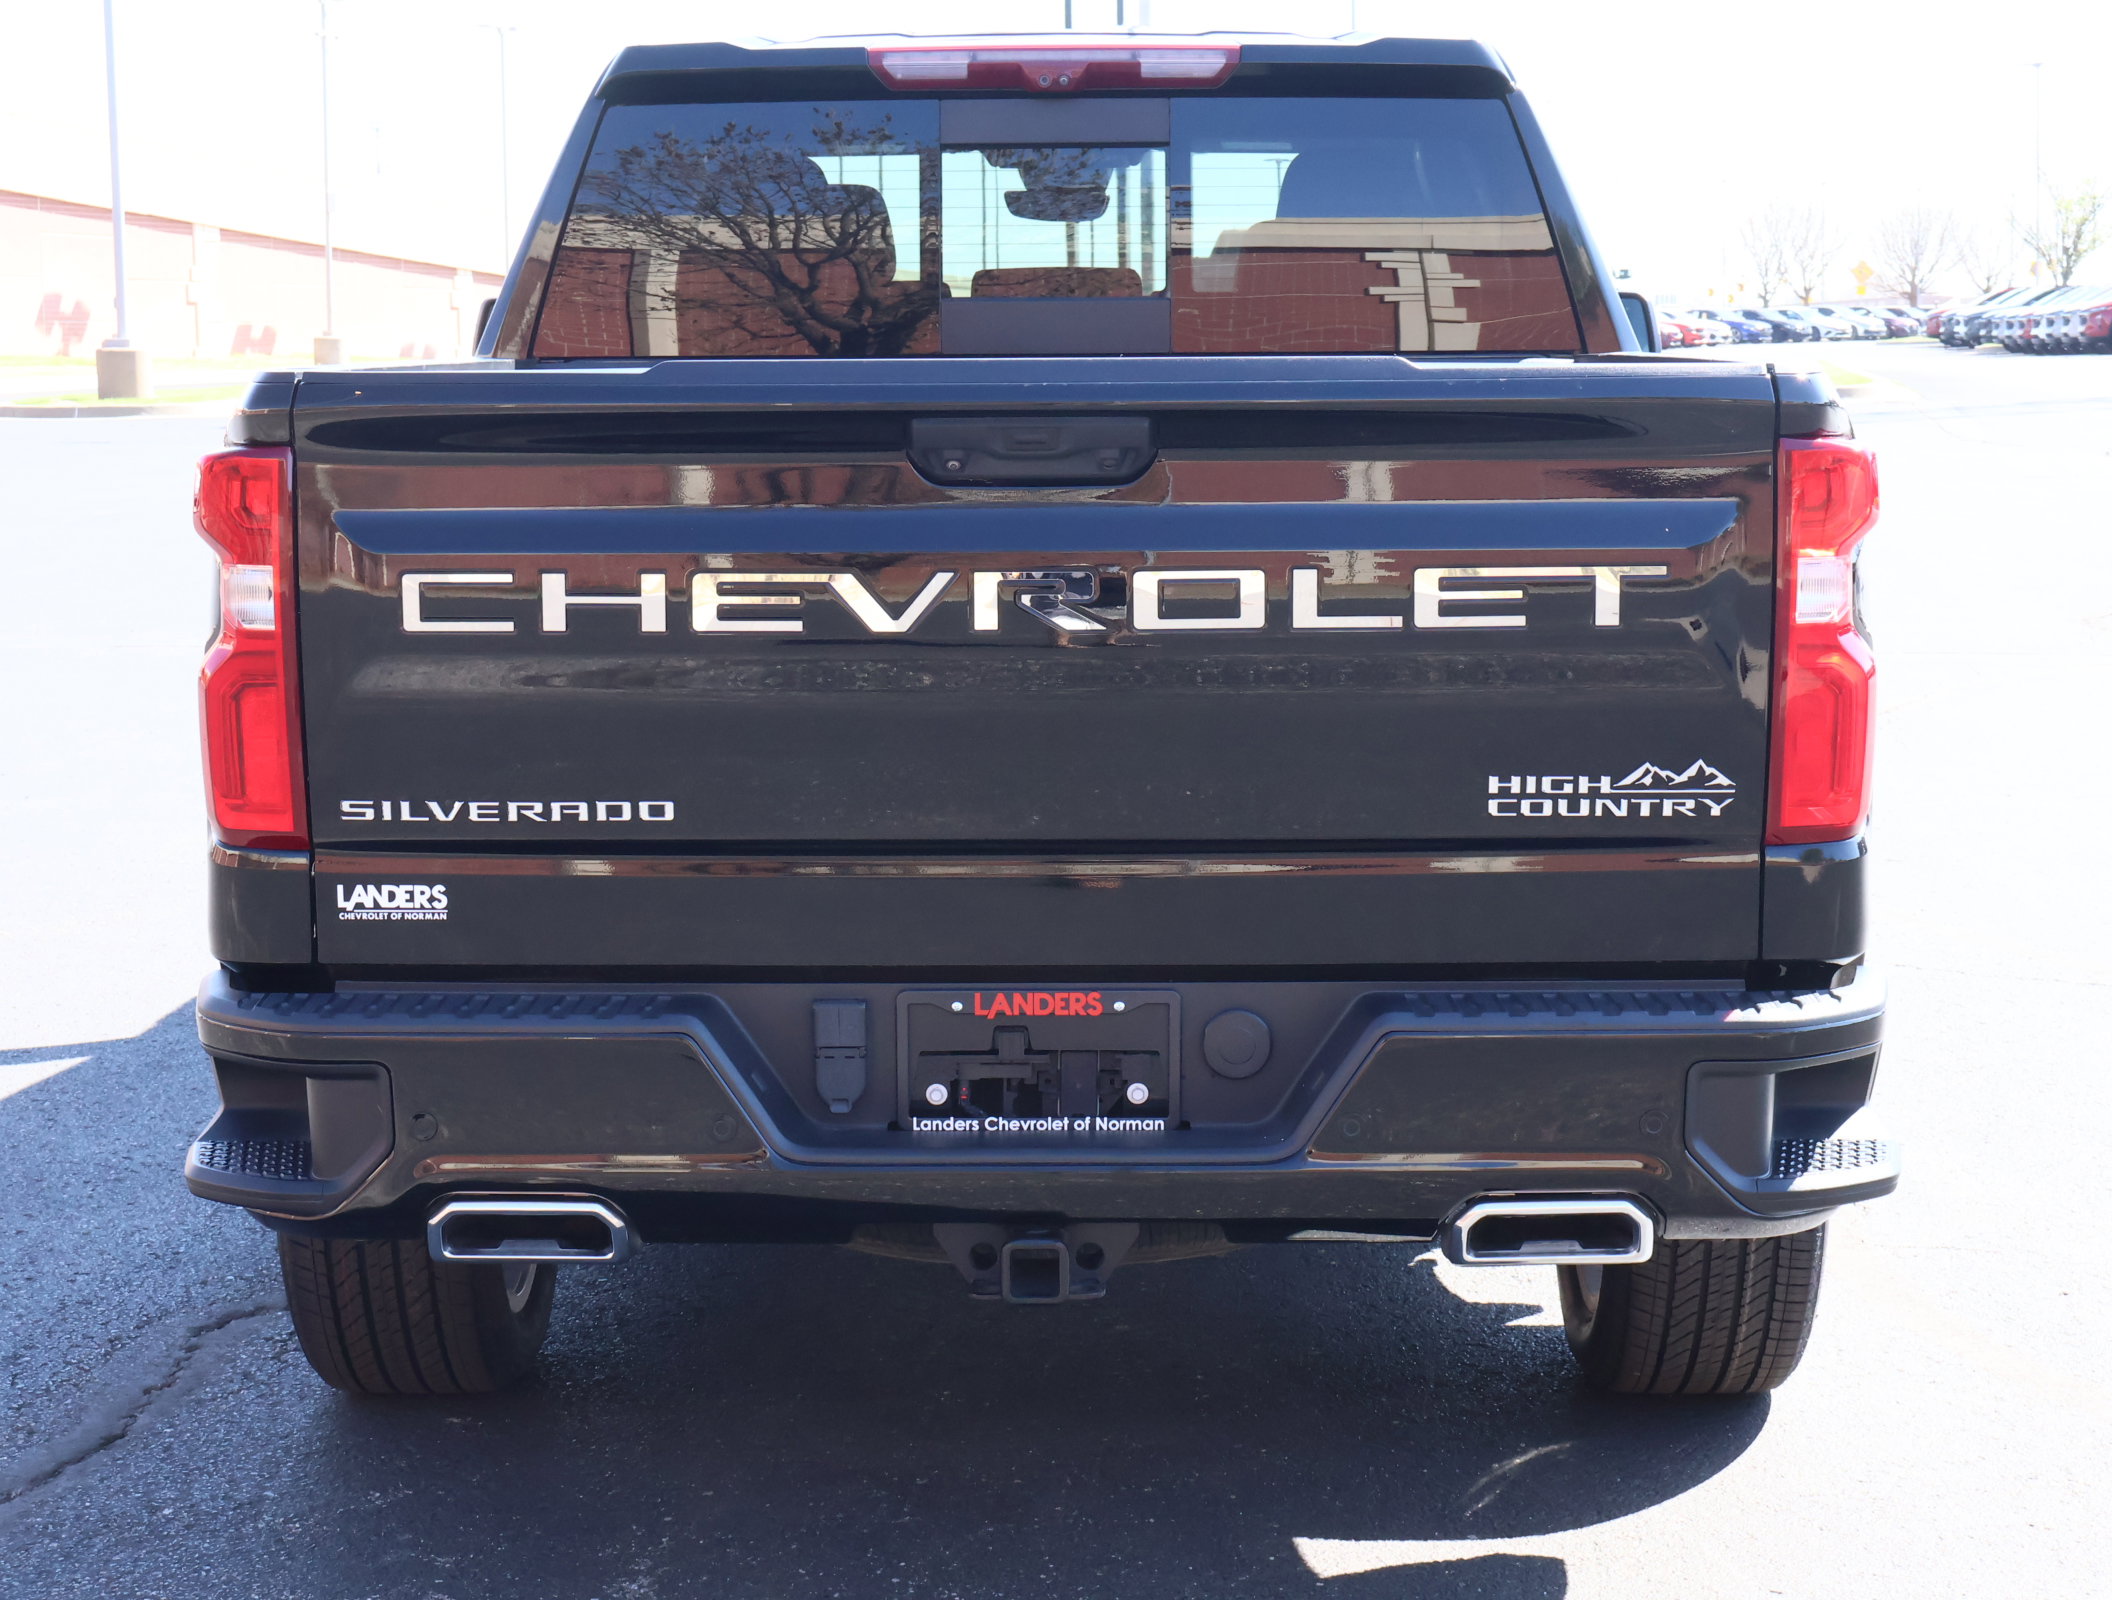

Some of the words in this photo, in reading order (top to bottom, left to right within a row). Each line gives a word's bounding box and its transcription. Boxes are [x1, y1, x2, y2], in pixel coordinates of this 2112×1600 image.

[401, 565, 1668, 632] CHEVROLET
[1488, 775, 1612, 794] HIGH
[339, 800, 675, 822] SILVERADO
[1487, 797, 1735, 817] COUNTRY
[336, 884, 448, 911] LANDERS
[338, 912, 388, 920] CHEVROLET
[390, 912, 402, 920] OF
[404, 912, 447, 920] NORMAN
[973, 991, 1103, 1019] LANDERS
[912, 1116, 979, 1131] Landers
[984, 1116, 1069, 1131] Chevrolet
[1073, 1116, 1091, 1131] of
[1095, 1117, 1165, 1131] Norman
